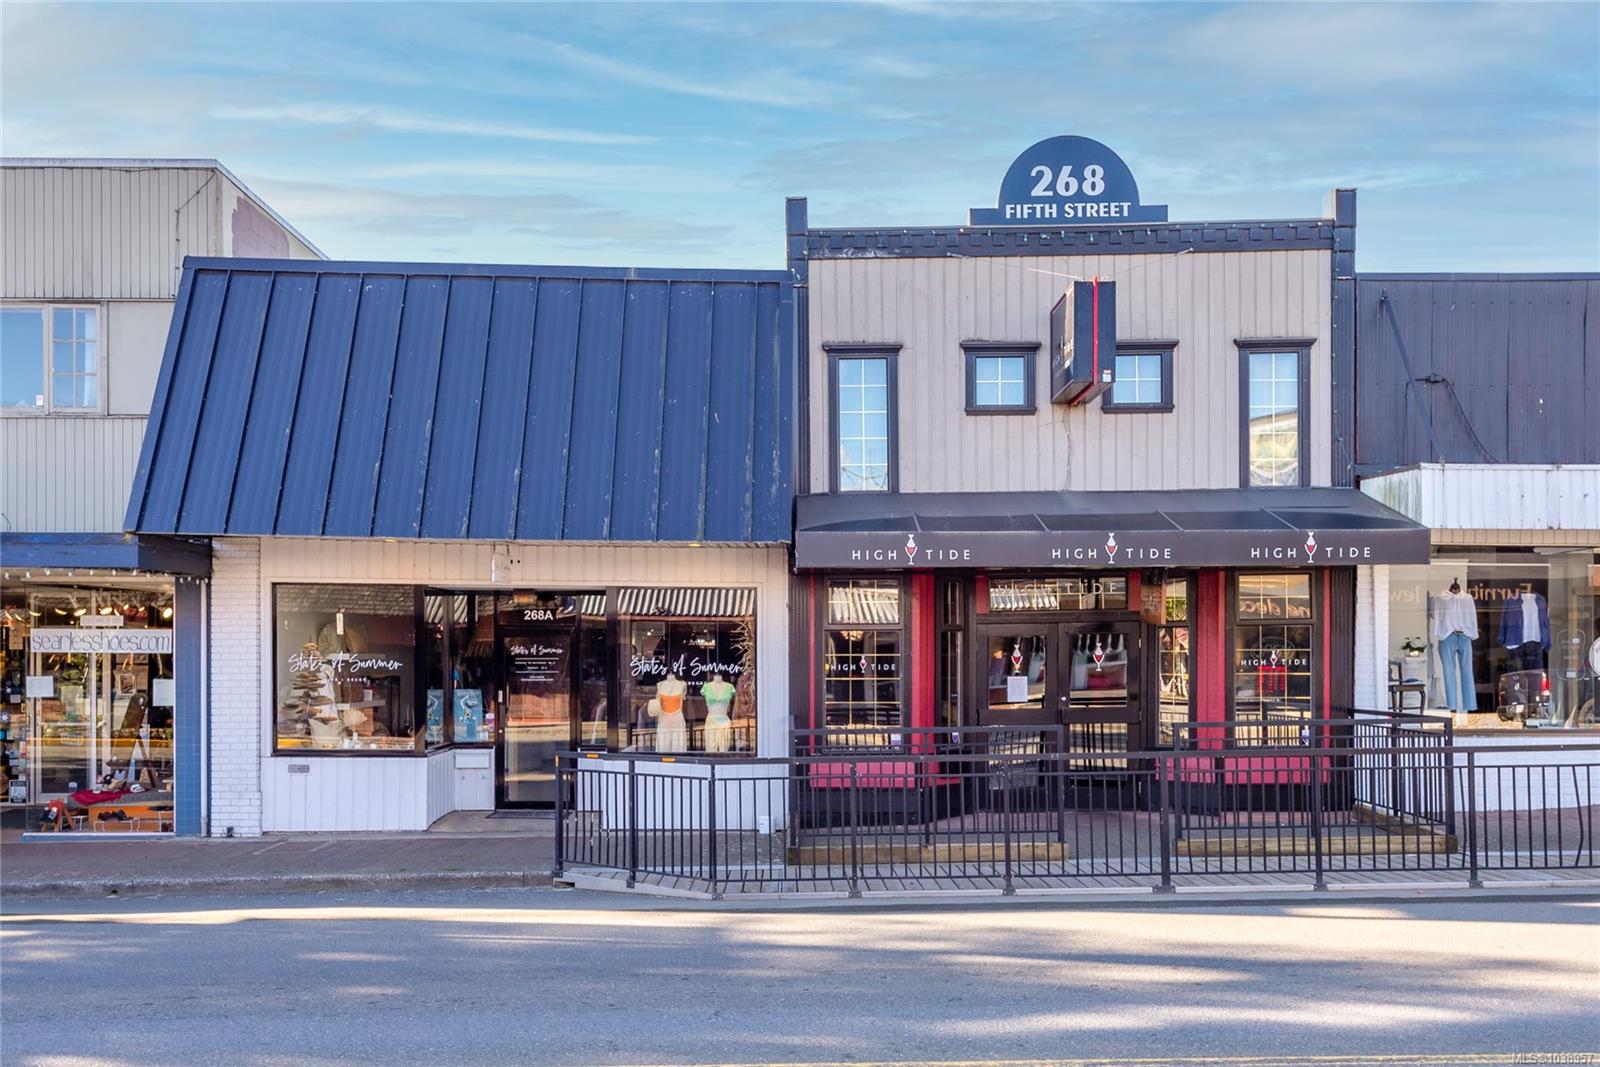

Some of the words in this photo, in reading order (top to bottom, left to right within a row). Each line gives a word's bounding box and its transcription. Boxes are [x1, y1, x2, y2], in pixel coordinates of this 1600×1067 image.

[1030, 164, 1106, 197] 268
[1005, 203, 1058, 219] FIFTH
[1064, 202, 1132, 218] STREET
[851, 549, 897, 561] HIGH
[925, 549, 971, 561] TIDE
[1052, 548, 1097, 560] HIGH
[1126, 547, 1171, 560] TIDE
[1251, 547, 1297, 559] HIGH
[1325, 546, 1371, 559] TIDE
[1064, 582, 1119, 595] TIDE
[523, 609, 554, 621] 268A
[32, 631, 170, 651] searlesshoes.com
[288, 650, 326, 673] States
[330, 650, 346, 672] of
[349, 653, 403, 673] Summer
[630, 656, 668, 677] States
[672, 653, 686, 676] of
[689, 656, 743, 677] Summer
[830, 663, 857, 671] HIGH
[870, 663, 896, 671] TIDE
[1240, 658, 1267, 667] HIGH
[1281, 657, 1308, 666] TIDE
